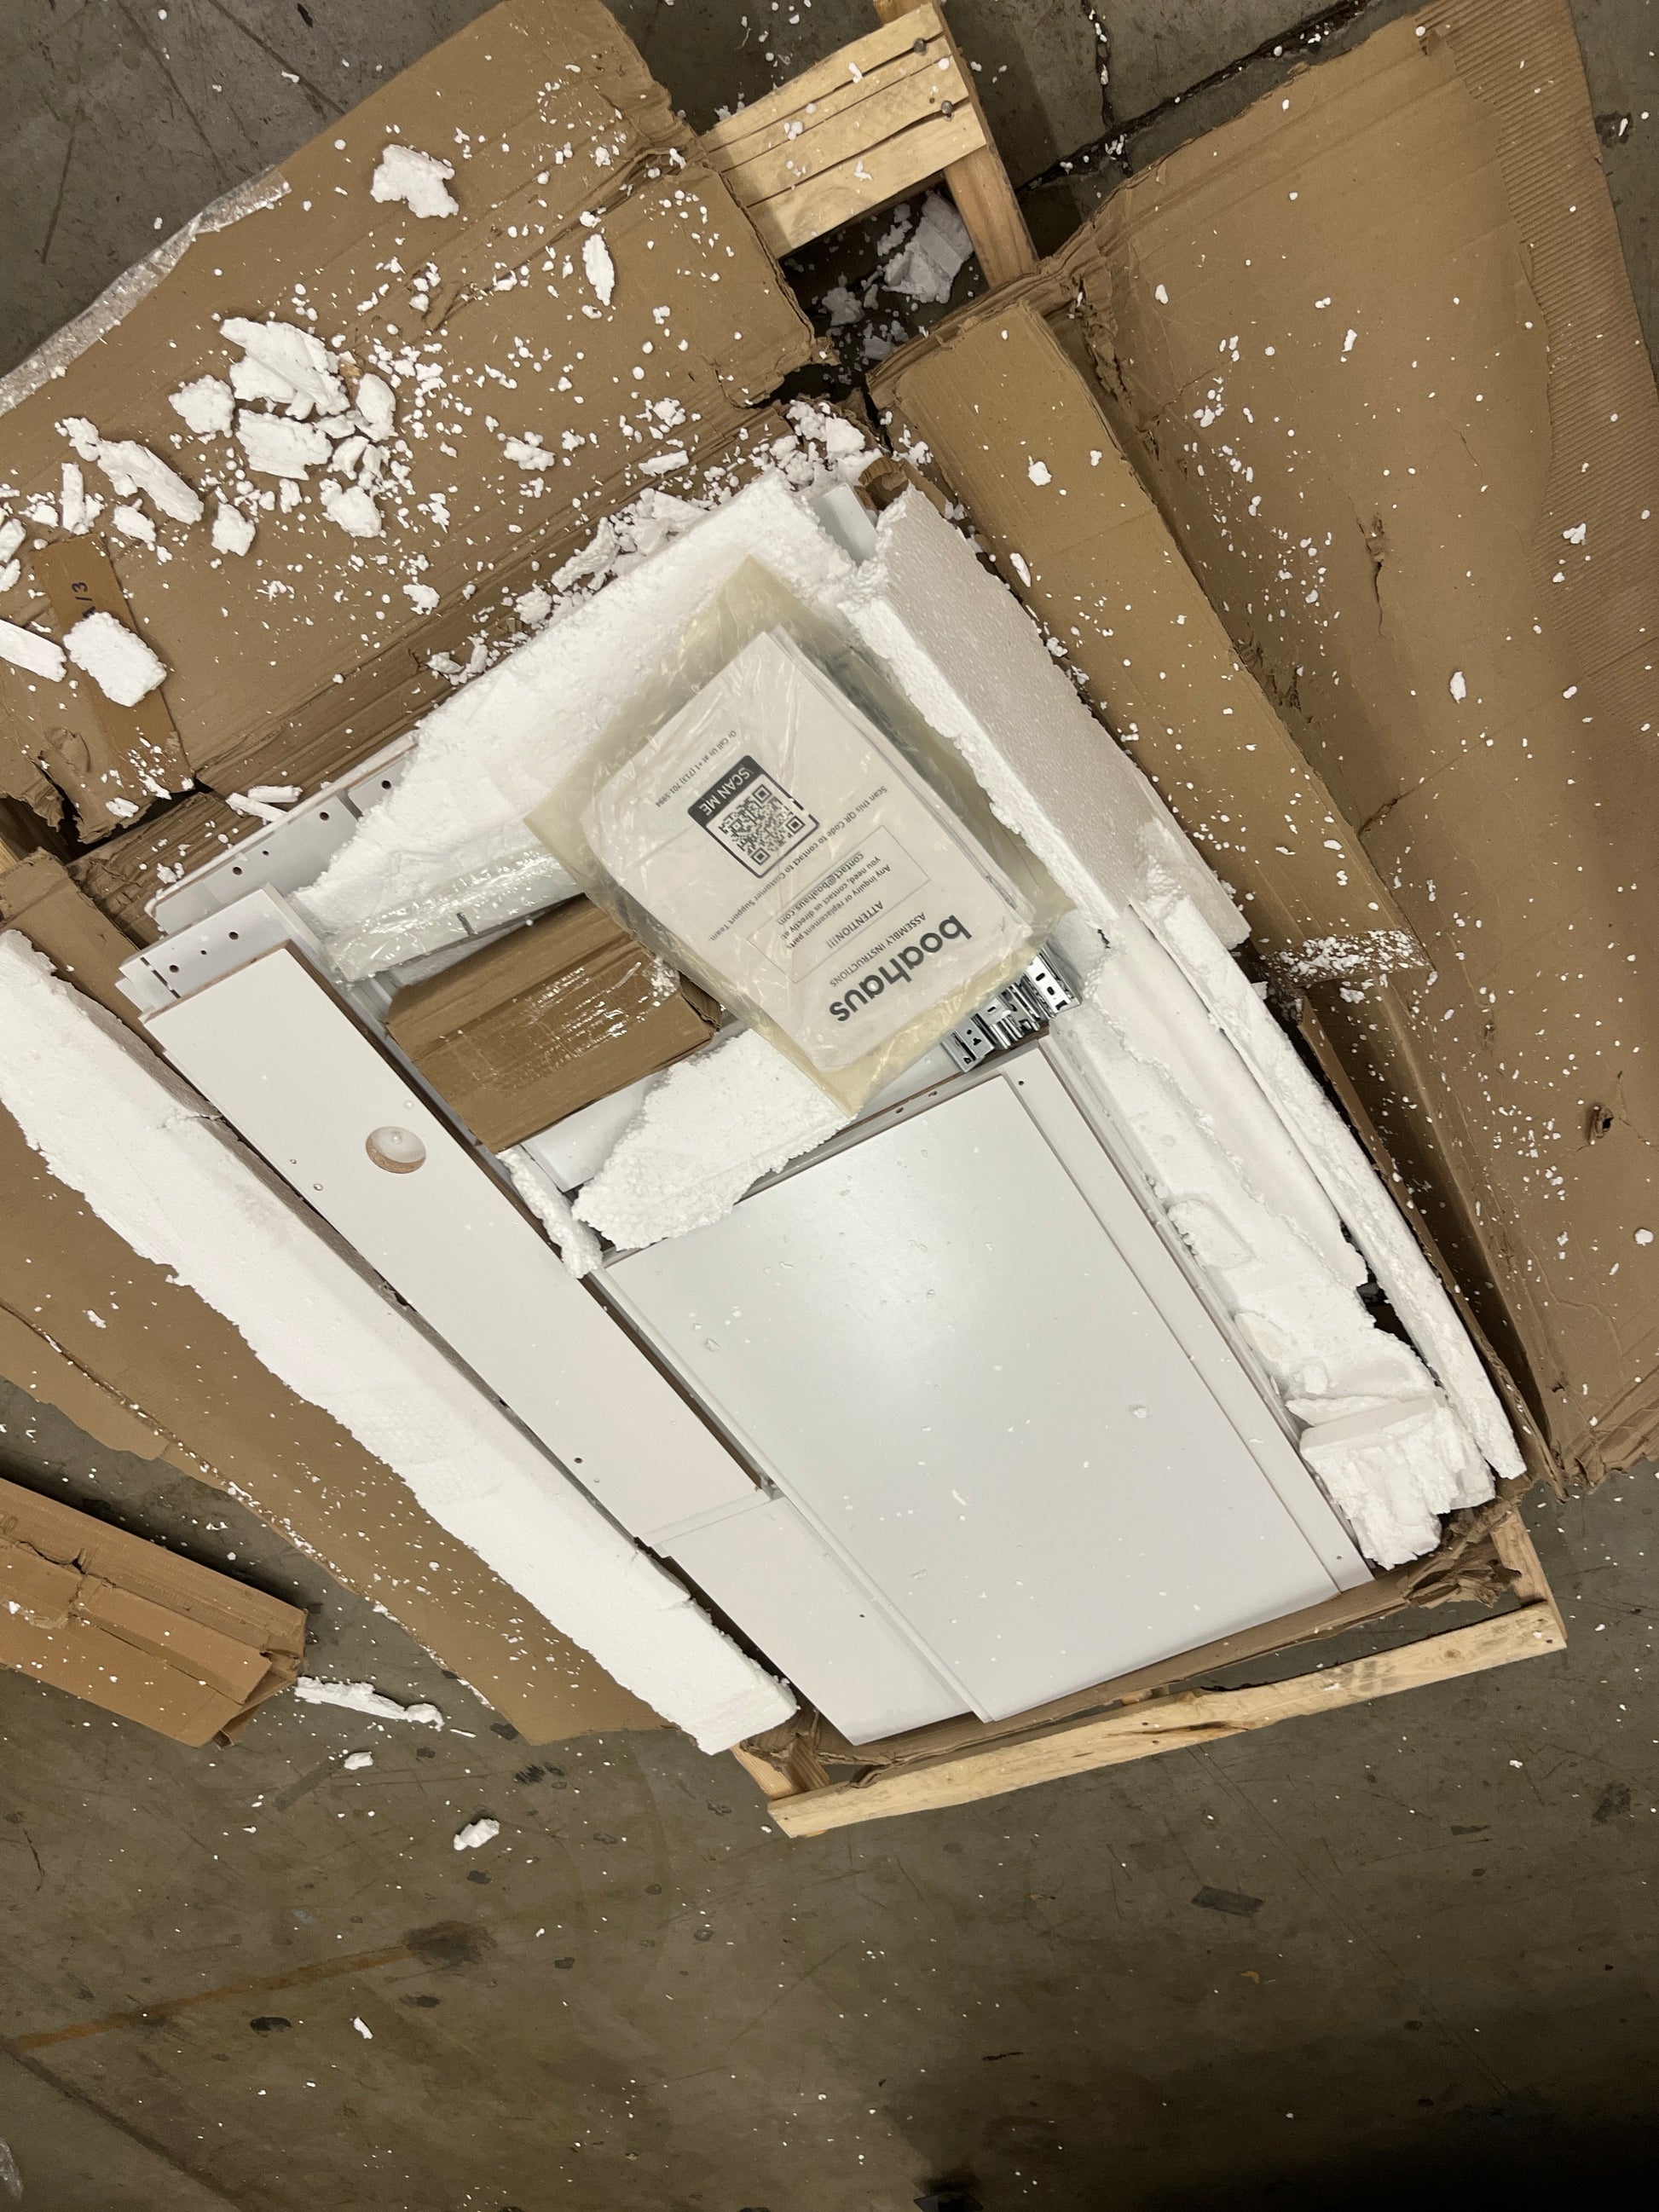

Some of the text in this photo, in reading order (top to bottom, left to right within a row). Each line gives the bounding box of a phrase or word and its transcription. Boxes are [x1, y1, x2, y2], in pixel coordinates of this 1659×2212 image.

[715, 736, 729, 750] Call
[727, 729, 737, 738] Or
[678, 766, 697, 784] (713)
[693, 761, 702, 770] +1
[698, 766, 750, 816] SCAN ME
[708, 785, 887, 941] Scan this QR Code to contact to Customer Support Team.
[865, 855, 882, 869] you
[846, 867, 867, 885] need,
[776, 851, 864, 925] contact@boahaus.com
[821, 882, 847, 904] contact
[785, 863, 891, 949] Any inquiry or replacement parts
[812, 902, 824, 911] us
[788, 910, 814, 933] directly
[825, 899, 883, 949] ATTENTION!!!
[829, 911, 926, 987] ASSEMBLY INSTRUCTIONS
[828, 914, 972, 1021] boahaus
